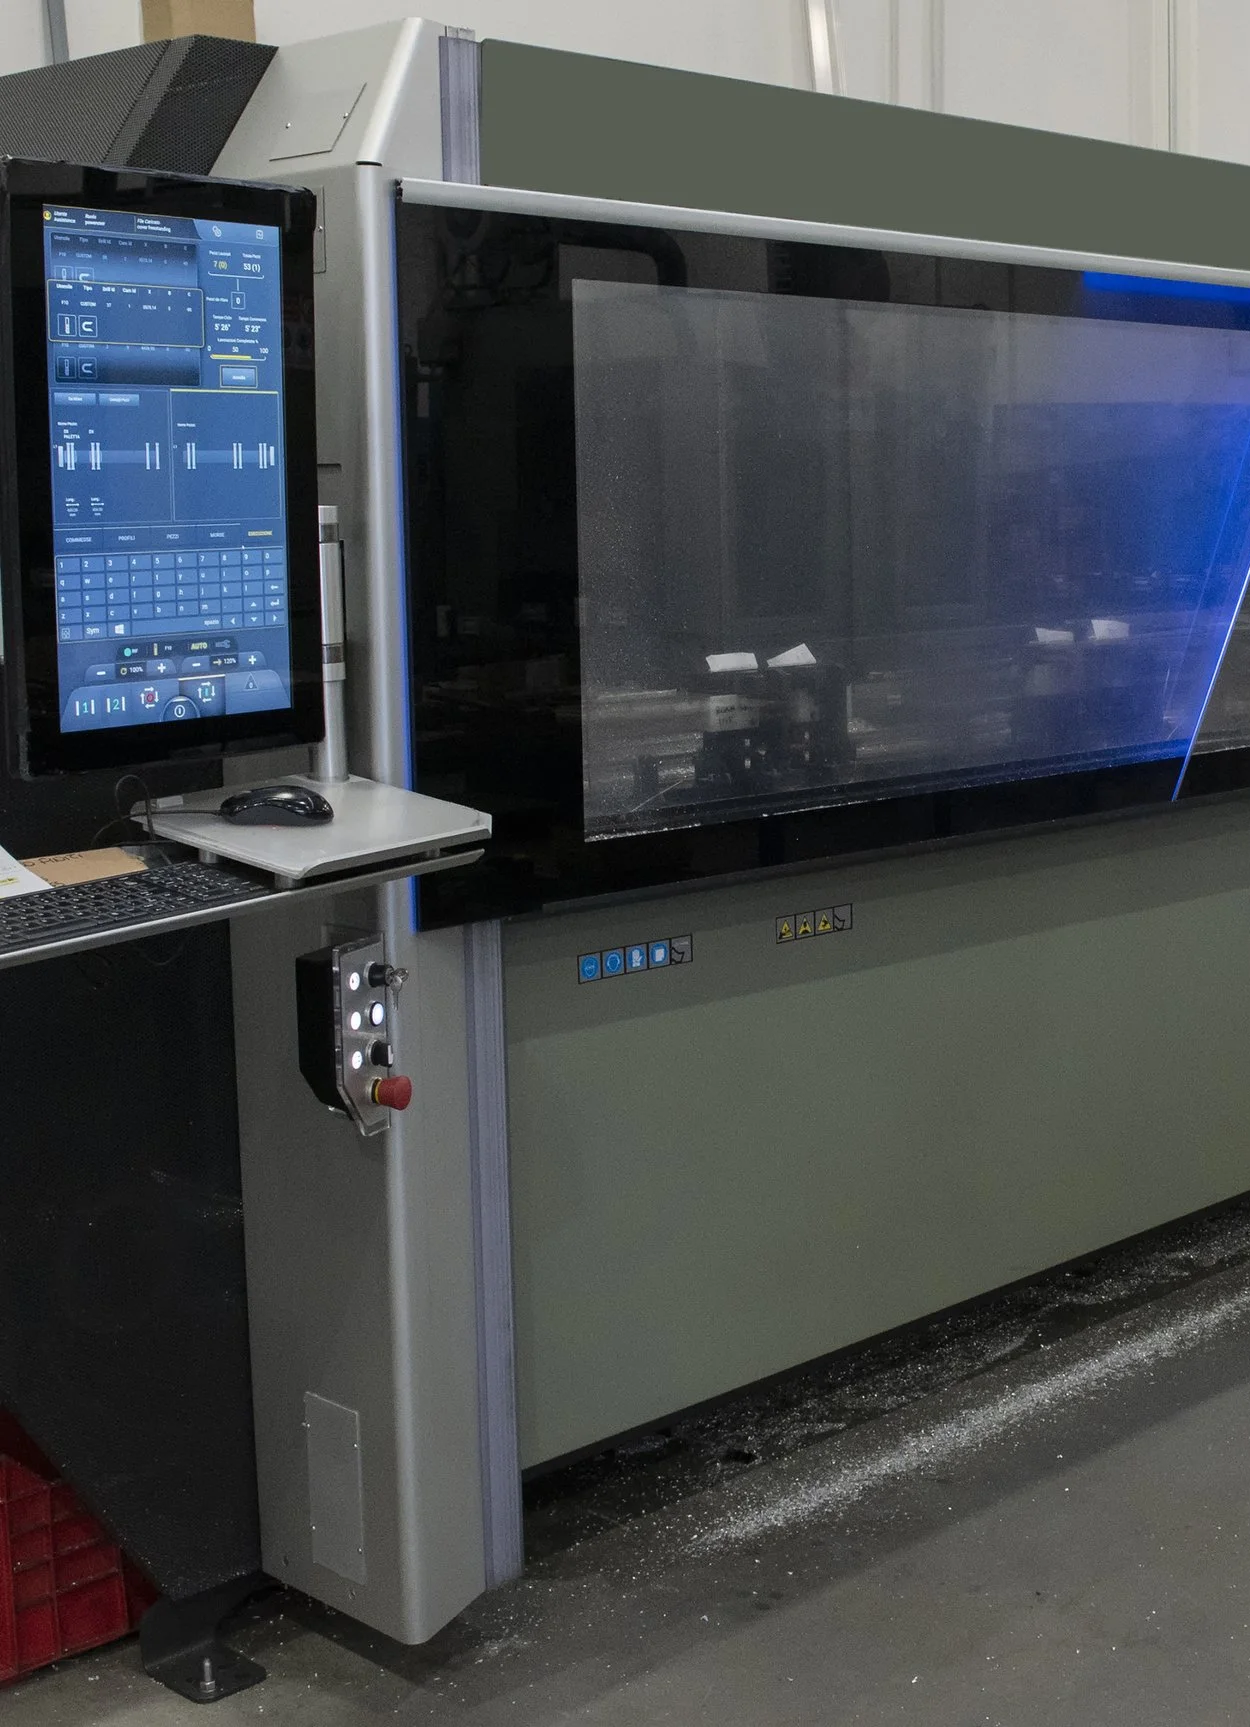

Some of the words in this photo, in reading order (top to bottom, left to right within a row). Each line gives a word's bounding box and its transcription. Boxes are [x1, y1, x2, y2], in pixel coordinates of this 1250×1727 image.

[252, 264, 261, 272] (1)
[86, 627, 100, 636] Sym
[190, 642, 208, 650] AUTO
[83, 702, 88, 713] 1
[113, 699, 119, 710] 2
